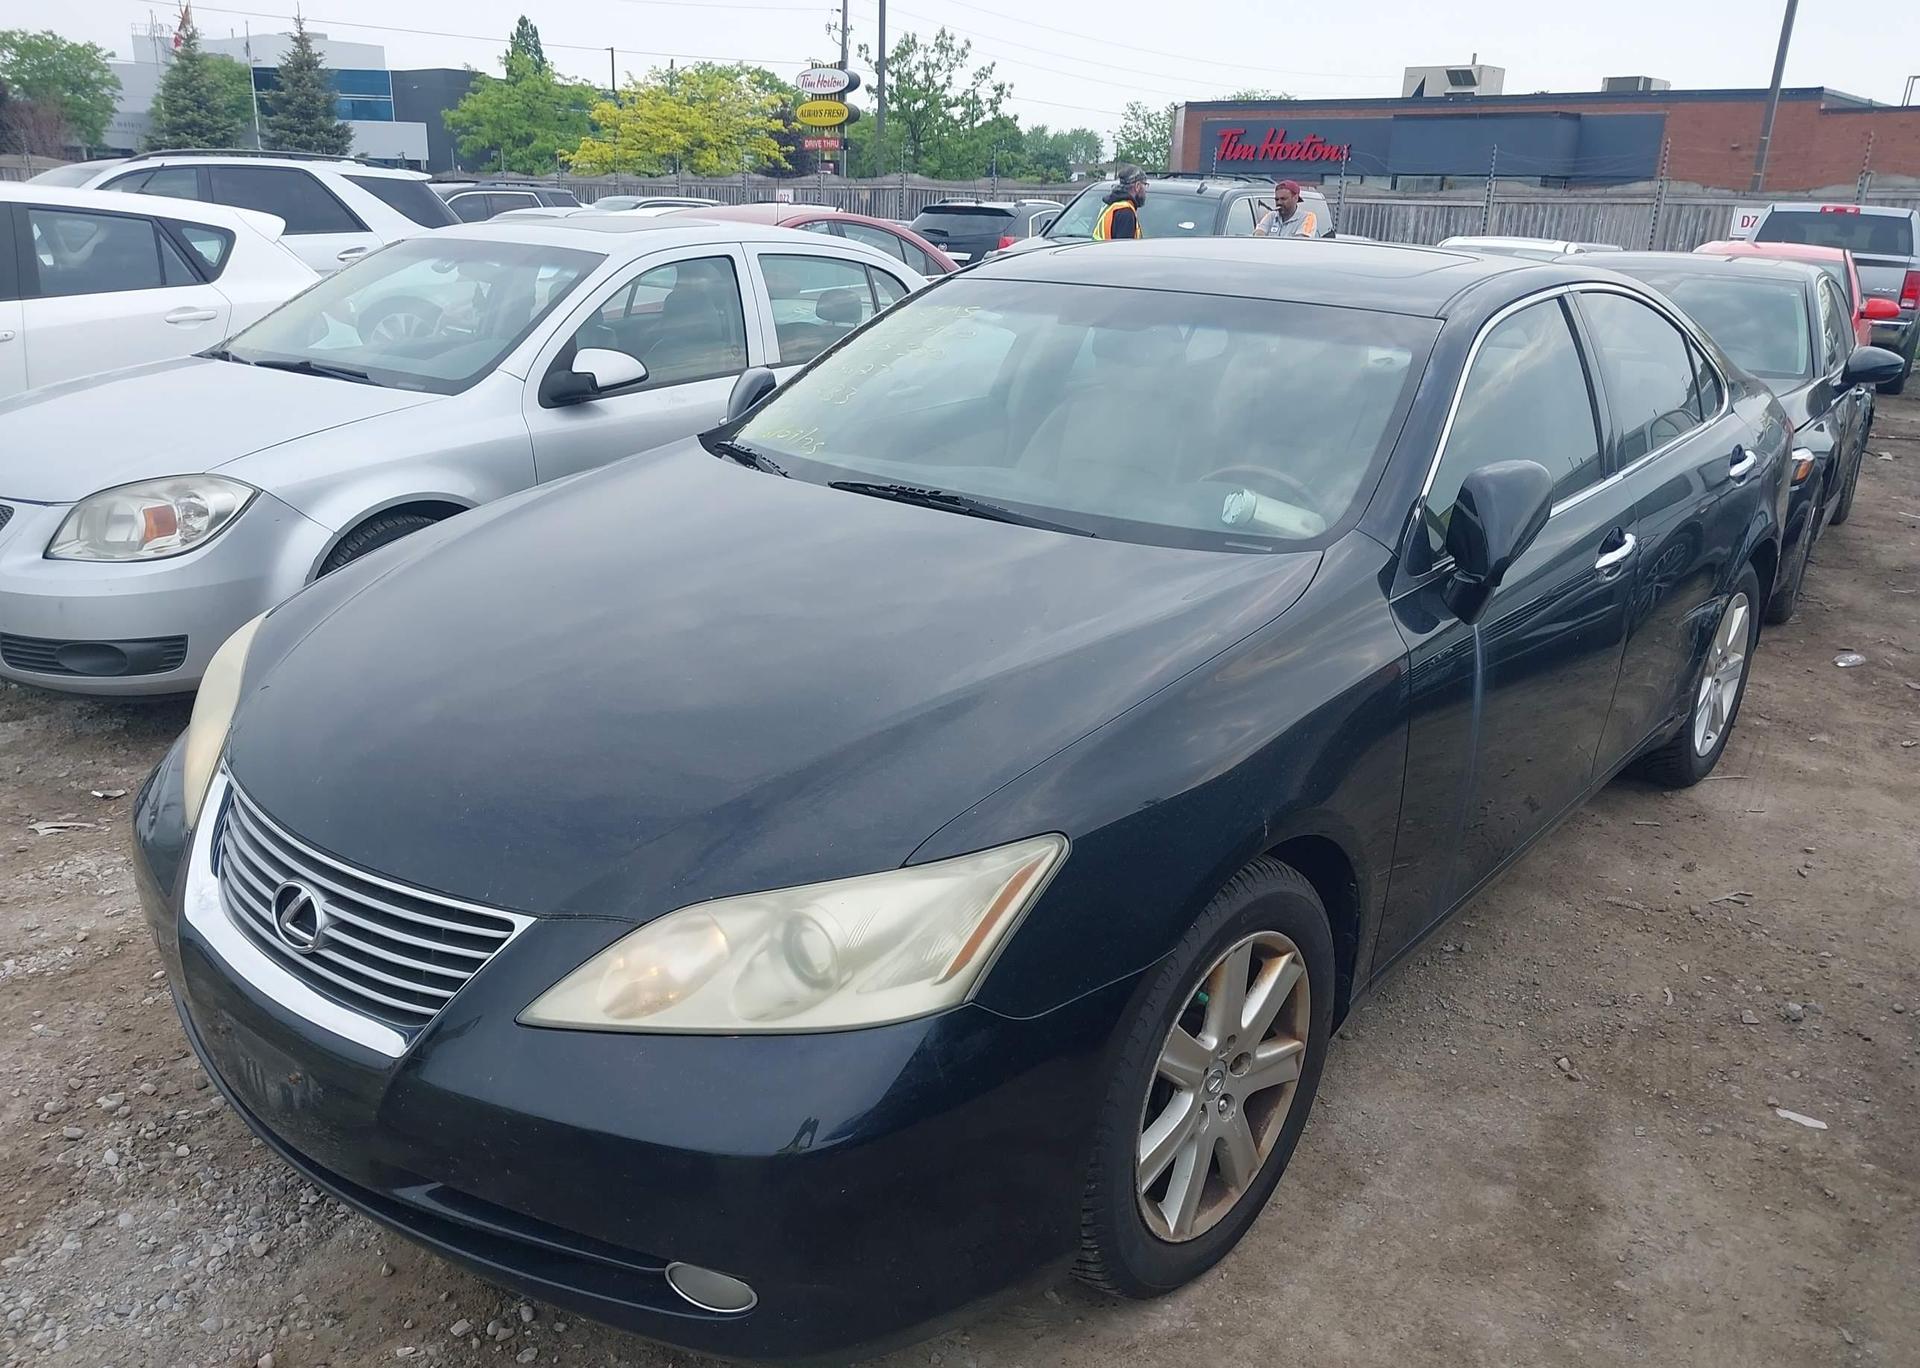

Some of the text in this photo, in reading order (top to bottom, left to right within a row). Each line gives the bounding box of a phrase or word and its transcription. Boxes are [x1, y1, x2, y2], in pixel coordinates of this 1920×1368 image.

[801, 73, 845, 89] Tim Hortons
[800, 108, 845, 119] ALWAYS FRESH
[804, 139, 839, 148] DRIVE THRU
[1217, 127, 1351, 161] Tim Hortons
[1741, 215, 1759, 228] D7
